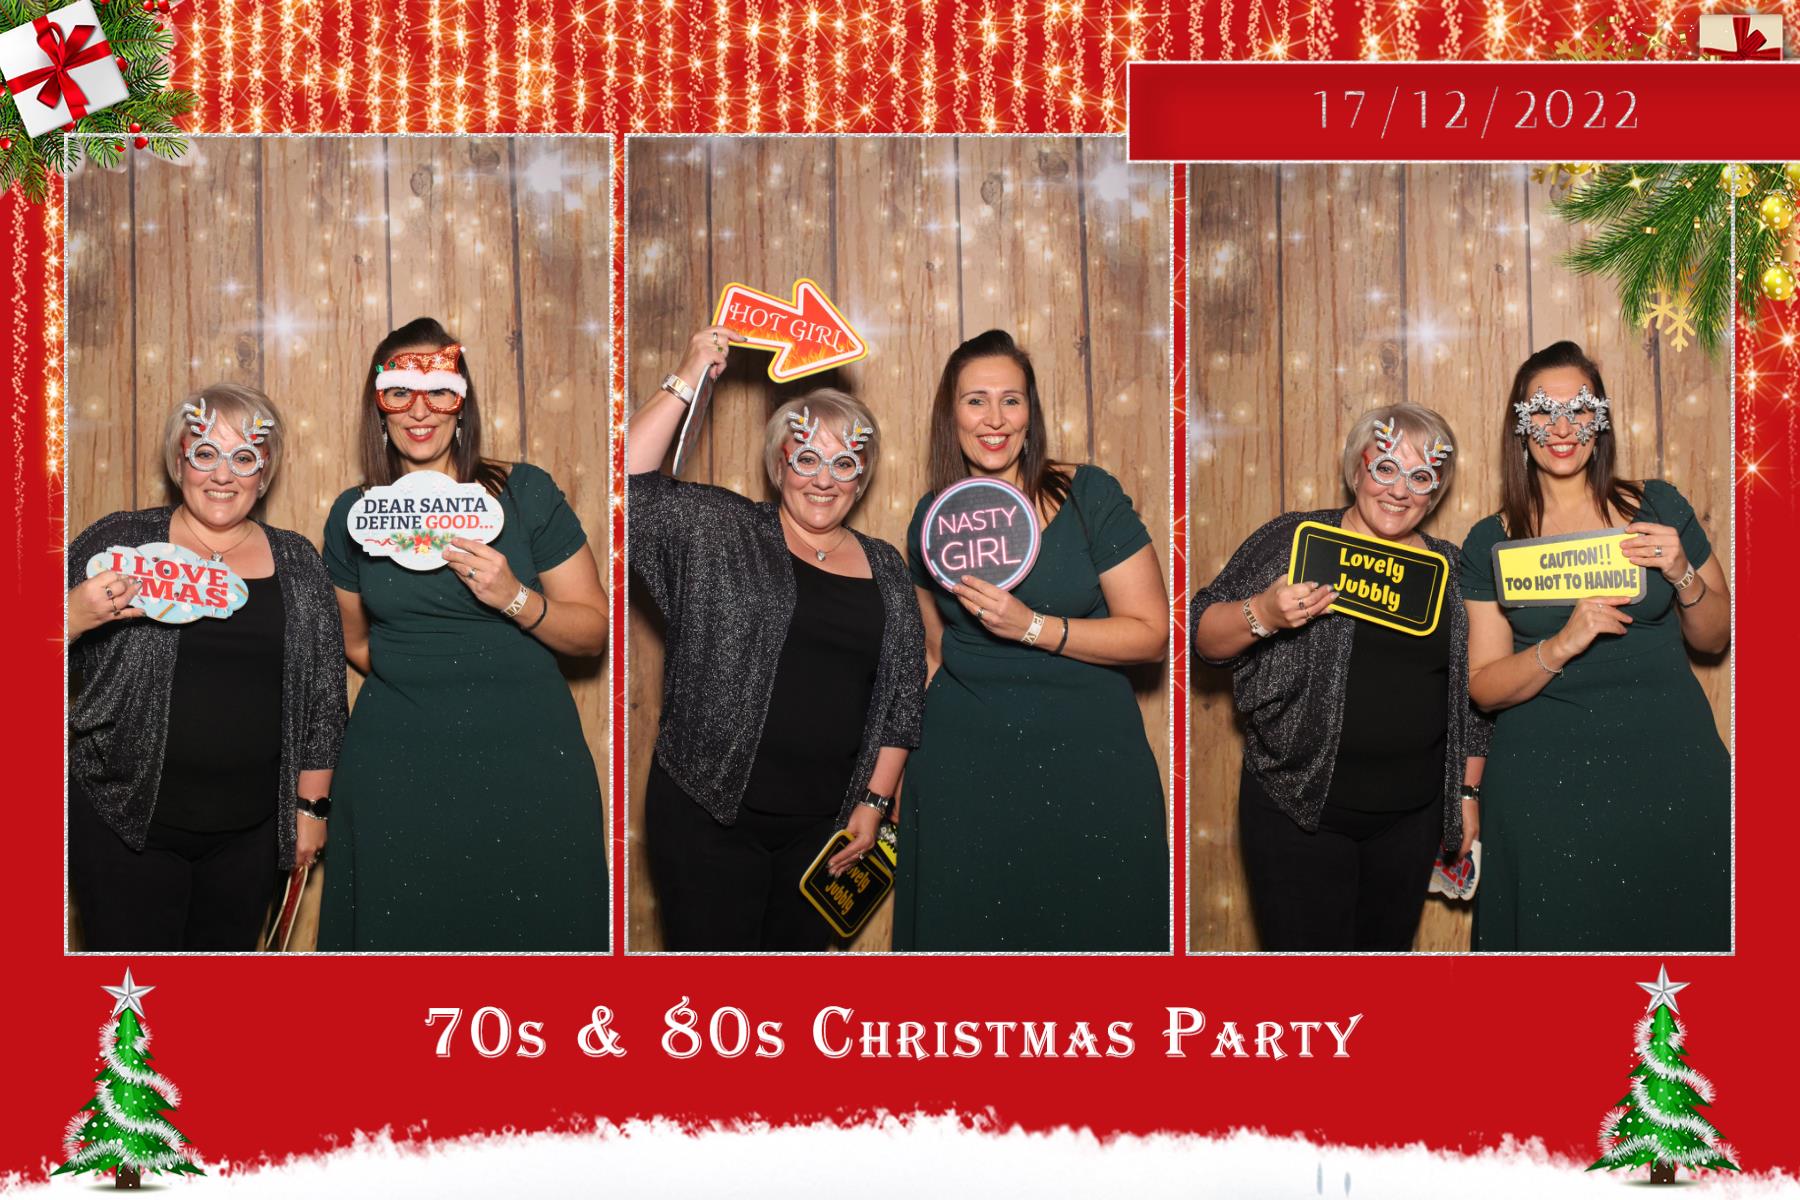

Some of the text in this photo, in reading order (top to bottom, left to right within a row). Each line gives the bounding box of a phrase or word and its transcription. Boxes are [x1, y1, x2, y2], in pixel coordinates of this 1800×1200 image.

[729, 302, 845, 353] HOT GIRL
[355, 514, 494, 530] DEFINE GOOD...
[364, 497, 488, 514] DEAR SANTA
[938, 505, 1017, 536] NASTY
[941, 535, 1021, 571] GIRL
[1340, 547, 1405, 584] Lovely
[1540, 543, 1612, 570] CAUTION!!
[111, 552, 228, 589] I LOVE
[1505, 568, 1638, 591] TOO HOT TO HANDLE
[128, 575, 229, 609] MAS
[1333, 572, 1401, 612] Jubbly
